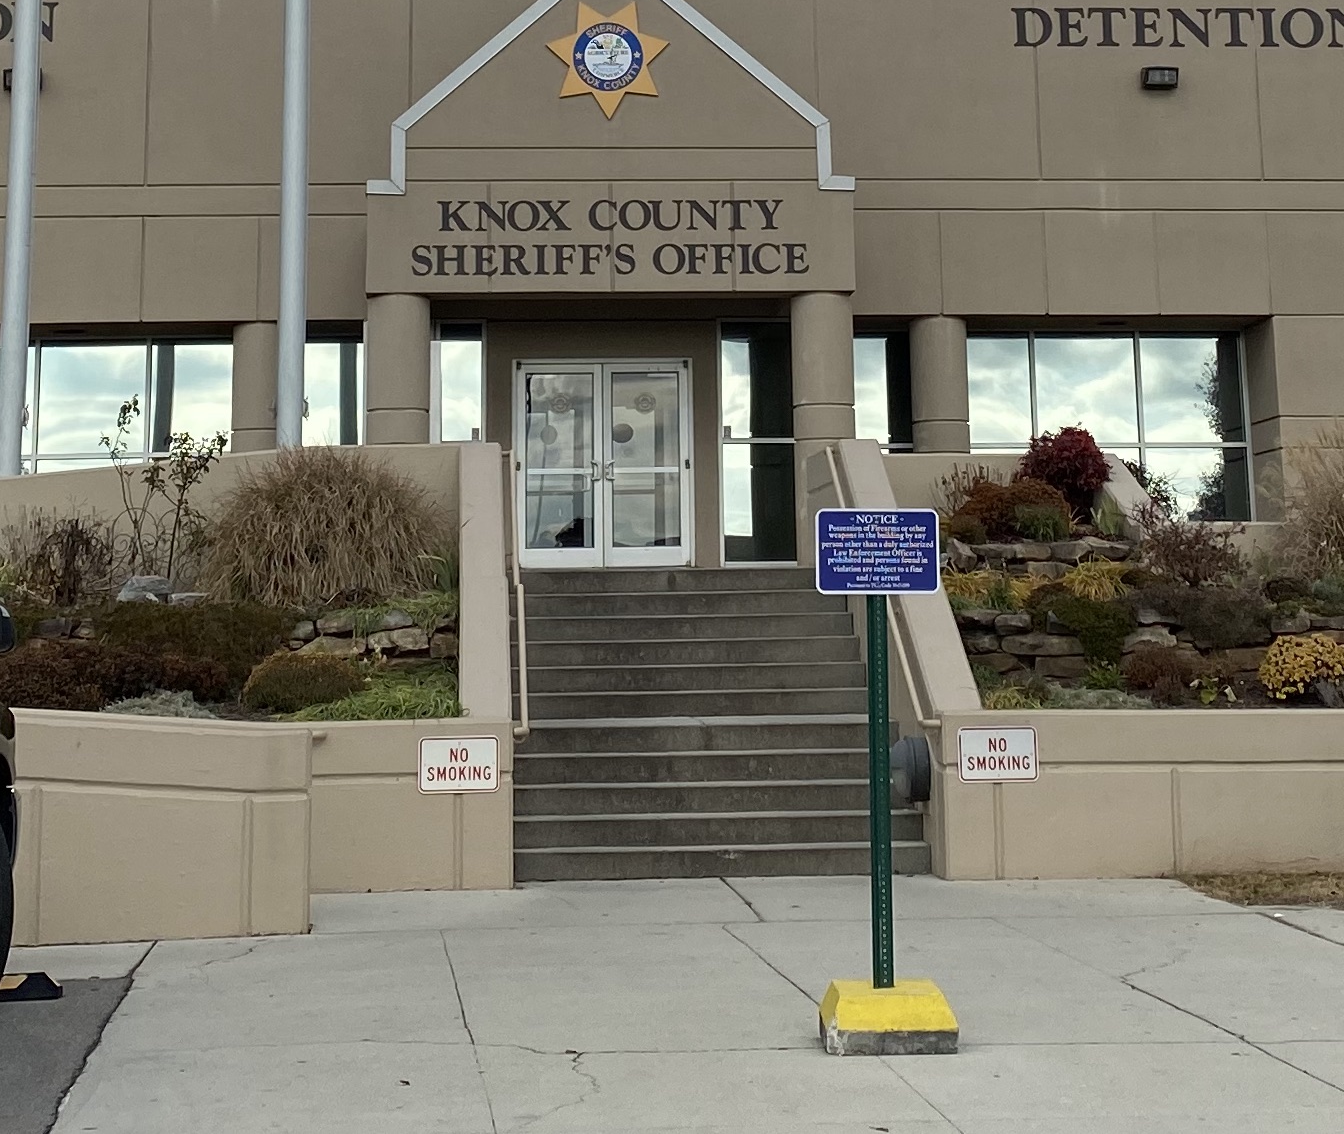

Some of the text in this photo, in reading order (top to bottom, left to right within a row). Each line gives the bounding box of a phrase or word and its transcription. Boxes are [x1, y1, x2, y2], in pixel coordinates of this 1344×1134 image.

[585, 24, 628, 38] SHERIFF
[577, 62, 640, 90] KNOX COUNTY
[436, 199, 784, 232] KNOX COUNTY
[411, 243, 810, 277] SHERIFF'S OFFICE
[856, 514, 899, 524] NOTICE
[871, 524, 900, 532] Firearms
[892, 548, 916, 556] Officer
[988, 737, 1007, 753] NO
[449, 747, 469, 763] NO
[967, 755, 1031, 771] SMOKING
[426, 765, 492, 782] SMOKING
